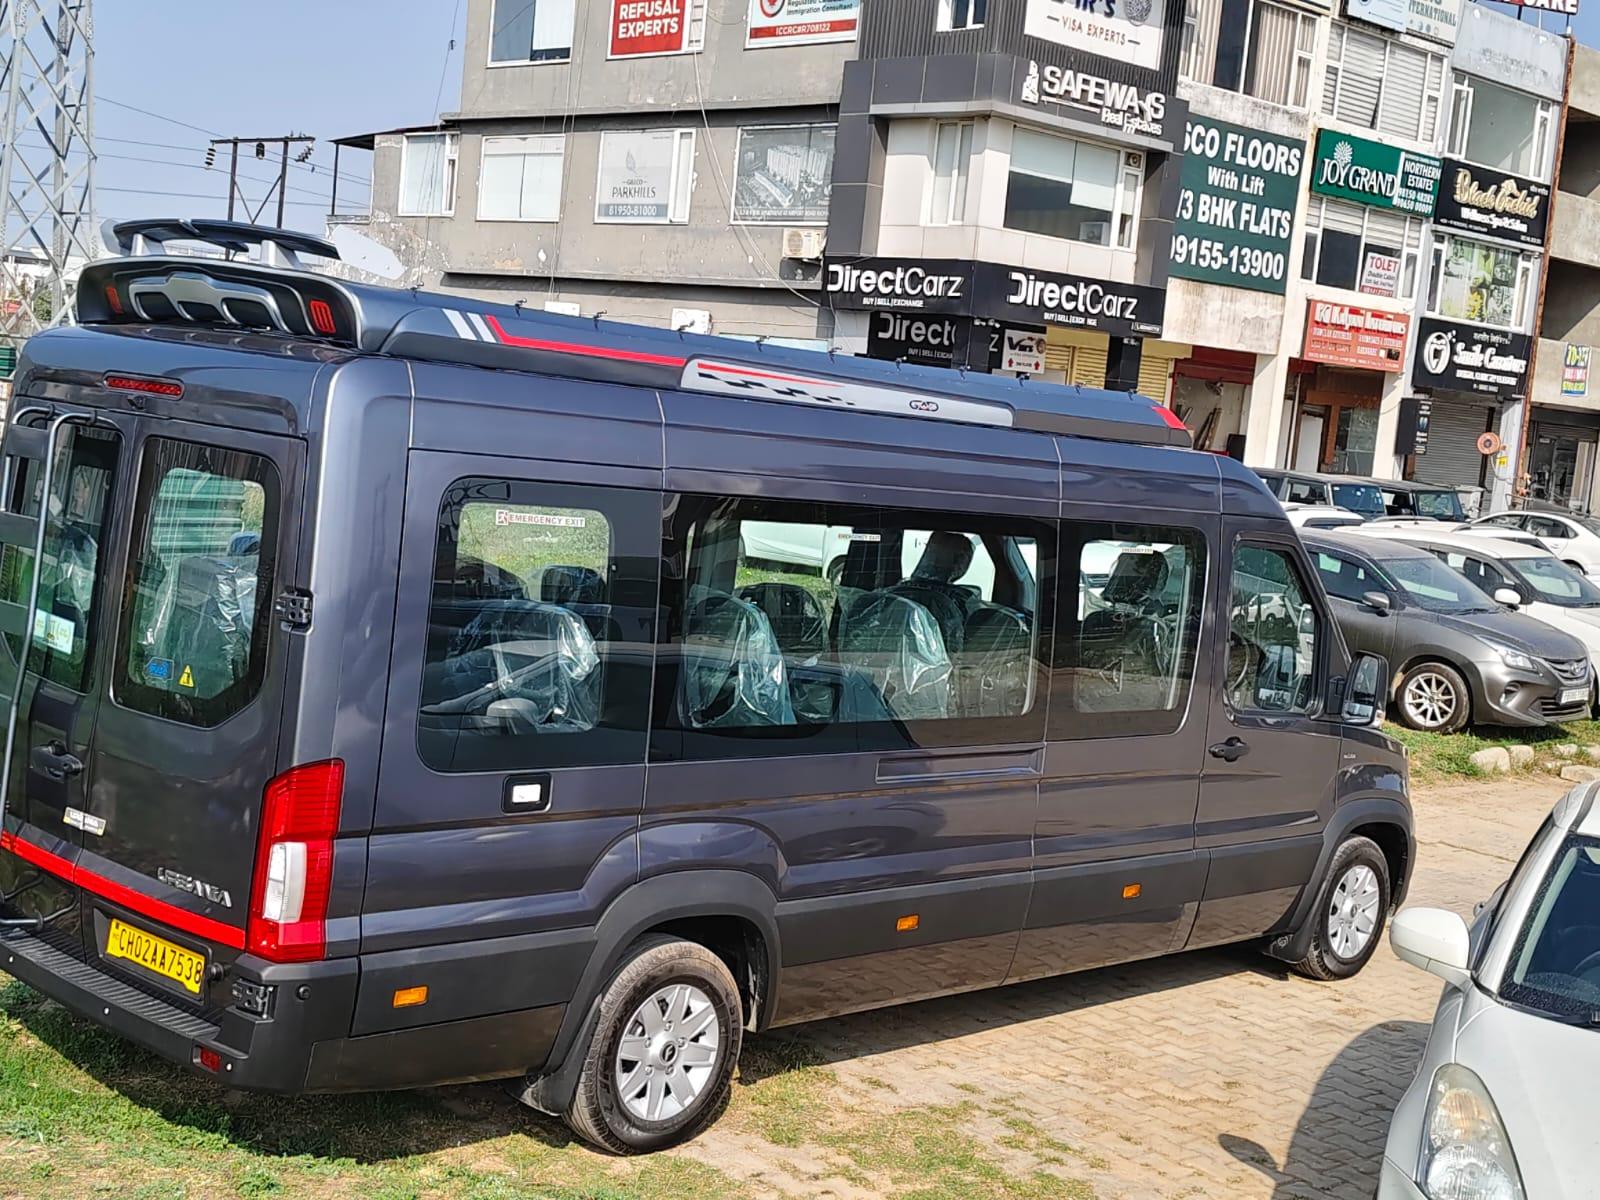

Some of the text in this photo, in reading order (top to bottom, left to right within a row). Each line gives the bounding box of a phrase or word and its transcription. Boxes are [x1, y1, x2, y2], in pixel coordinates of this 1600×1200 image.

[619, 0, 680, 20] REFUSAL
[787, 7, 820, 16] Immigration
[822, 3, 853, 13] Consultant
[618, 18, 679, 38] EXPERTS
[1062, 16, 1126, 46] VISA EXPERTS
[1042, 65, 1166, 121] SAFEWAYS
[1102, 107, 1123, 126] Real
[1223, 132, 1301, 177] FLOORS
[1207, 165, 1266, 196] With Lift
[1319, 158, 1398, 197] JOY GRAND
[1404, 161, 1442, 180] NORTHERN
[1407, 175, 1435, 191] ESTATES
[612, 186, 656, 199] PARKHILLS
[1453, 167, 1497, 210] Black
[1197, 193, 1237, 229] BHK
[1239, 202, 1292, 239] FLATS
[1370, 255, 1398, 272] TOLET
[827, 264, 965, 297] DirectCarz
[1007, 271, 1138, 319] DirectCarz
[509, 513, 585, 528] EMERGENCY EXIT
[119, 928, 203, 984] CH02AA7538
